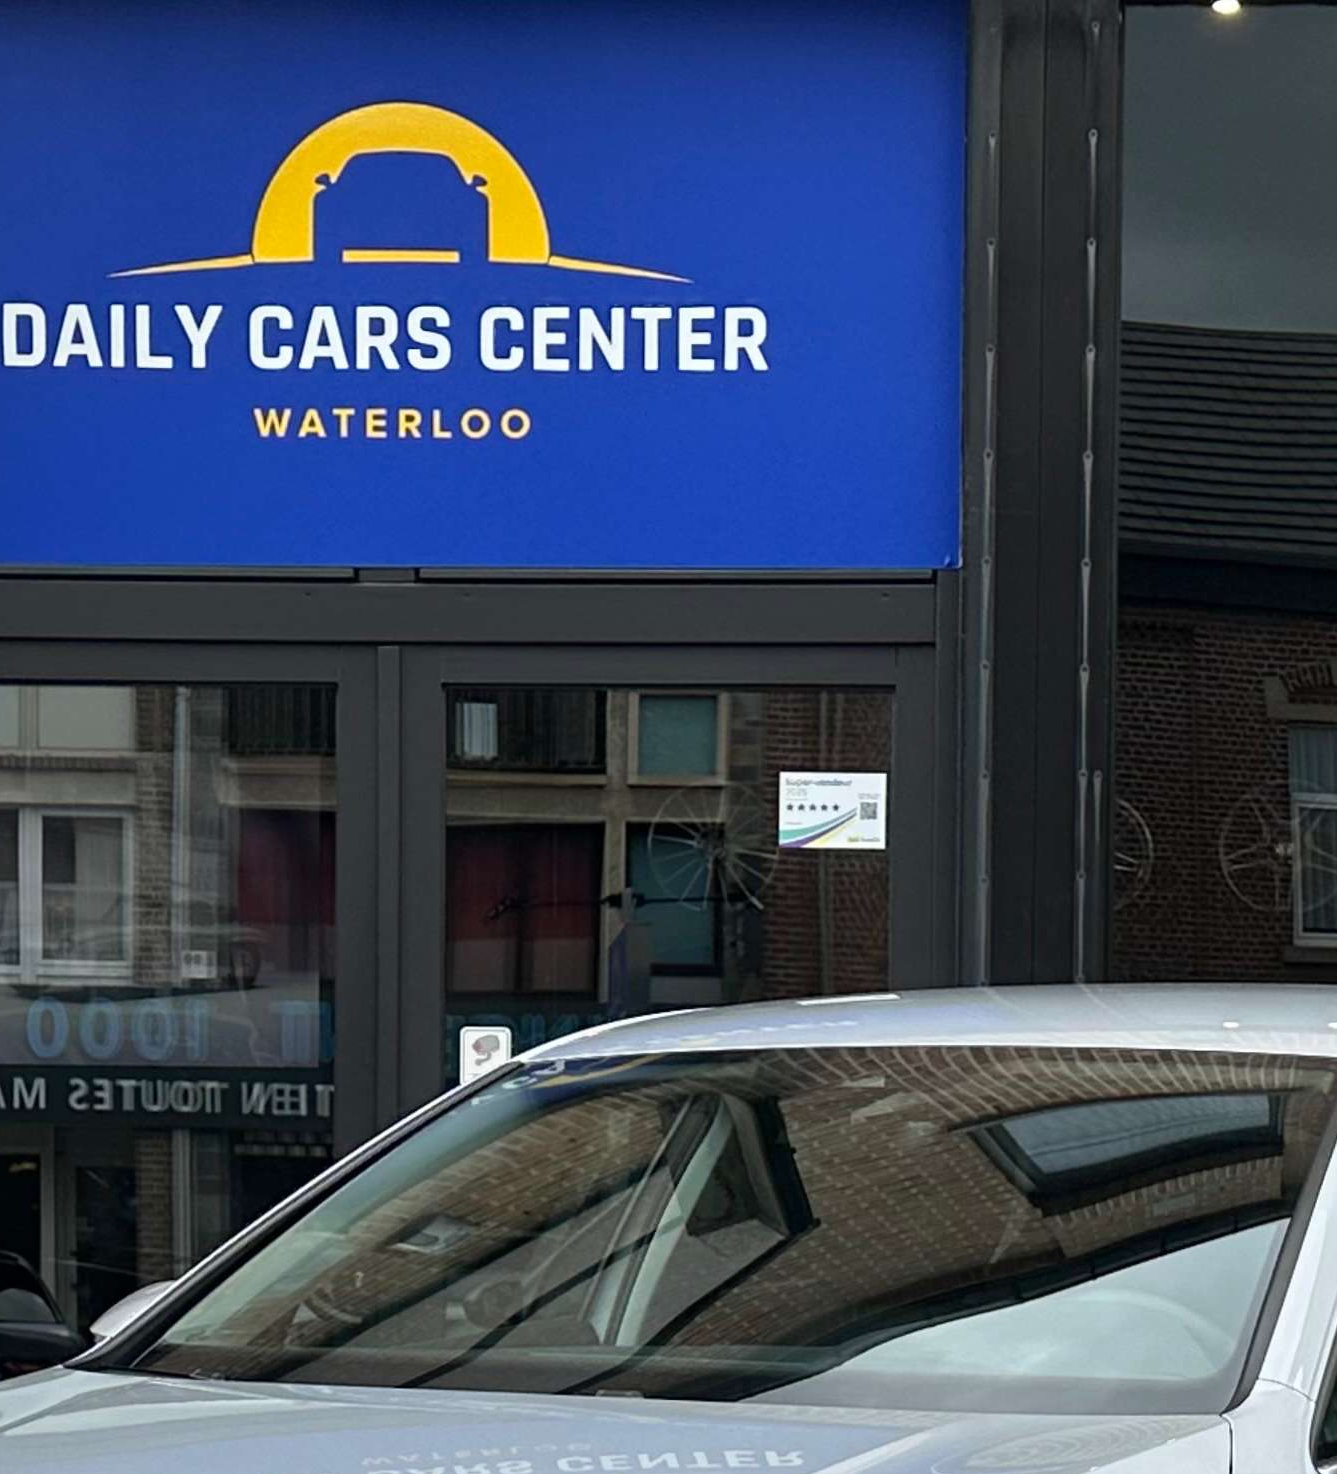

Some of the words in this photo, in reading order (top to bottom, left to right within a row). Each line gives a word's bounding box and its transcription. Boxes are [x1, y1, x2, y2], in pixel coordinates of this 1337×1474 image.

[1, 302, 224, 369] DAILY
[248, 304, 452, 370] CARS
[479, 305, 770, 372] CENTER
[253, 408, 532, 439] WATERLOO
